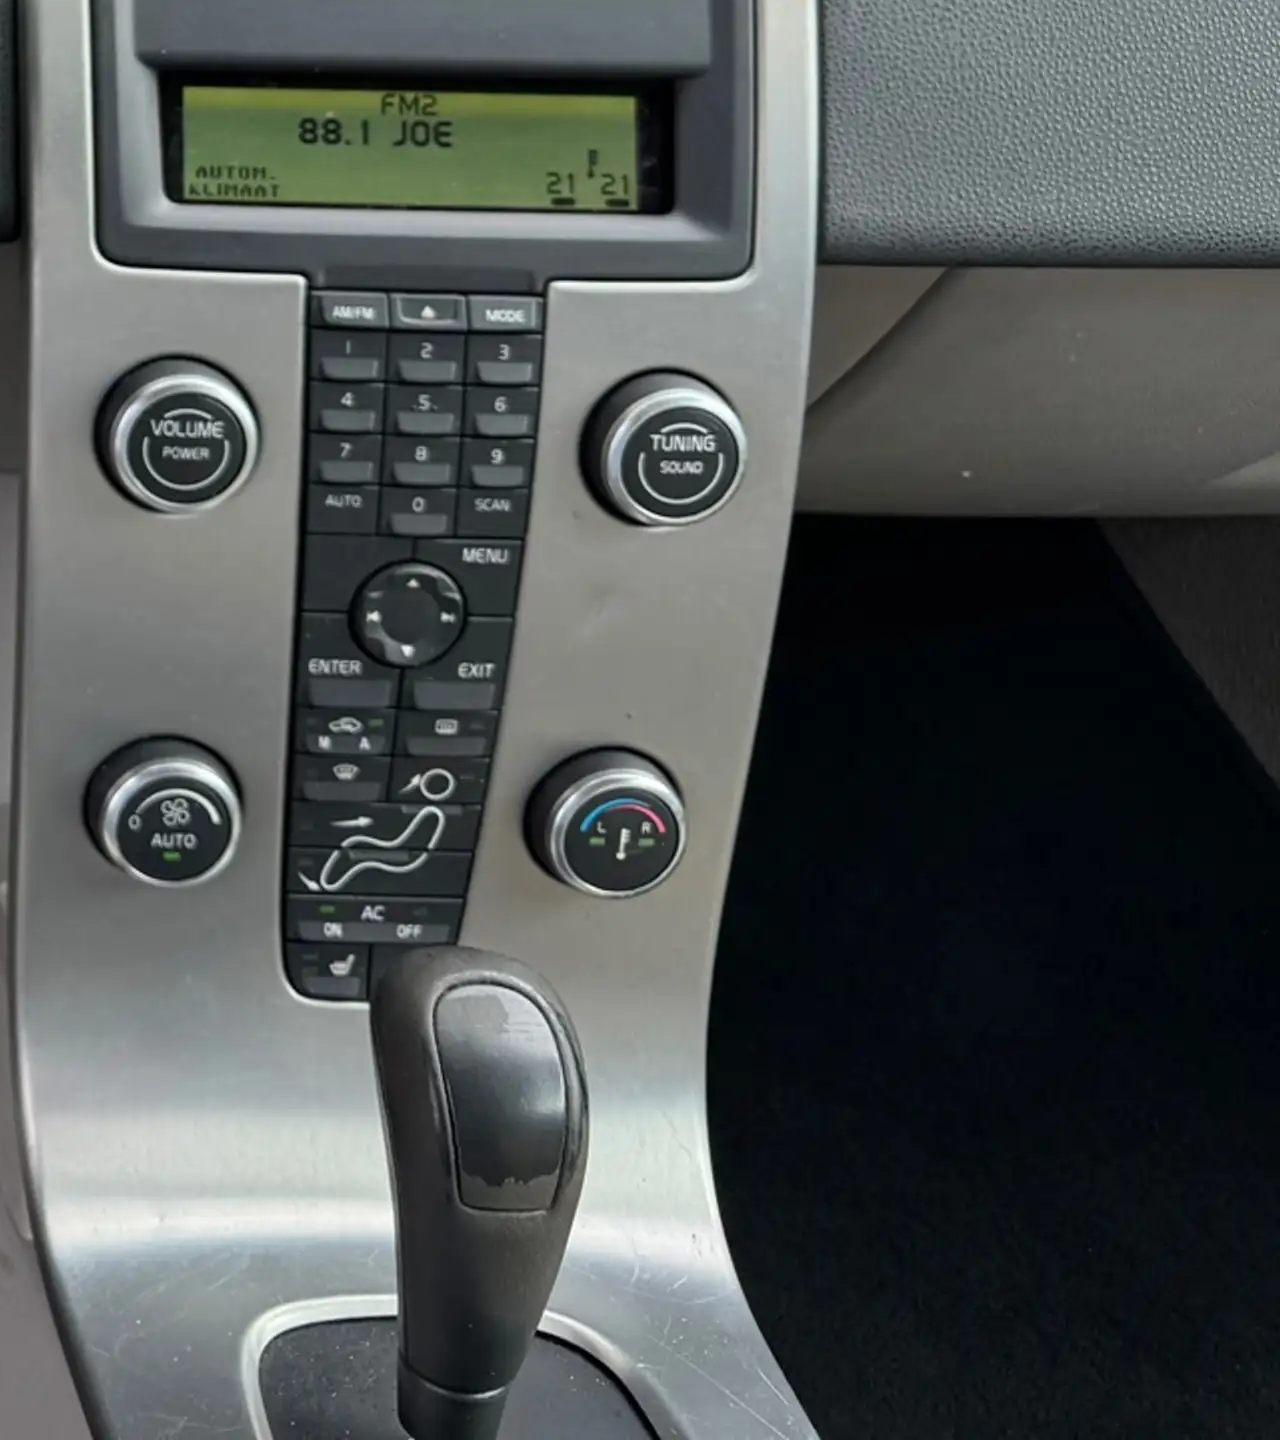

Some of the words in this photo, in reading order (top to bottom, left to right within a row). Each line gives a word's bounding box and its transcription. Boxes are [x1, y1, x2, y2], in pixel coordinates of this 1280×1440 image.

[381, 93, 441, 117] FM2
[298, 118, 371, 146] 88.1
[392, 120, 454, 148] JOE
[195, 165, 277, 182] AUTOM.
[188, 181, 281, 199] KLIMAAT
[545, 172, 576, 195] 21
[600, 173, 630, 196] 21
[484, 308, 526, 324] MODE
[420, 342, 434, 359] 2
[498, 344, 510, 360] 3
[340, 391, 354, 407] 4
[417, 393, 431, 410] 5
[494, 396, 507, 412] 6
[150, 418, 227, 440] VOLUME
[340, 442, 353, 459] 7
[649, 433, 718, 453] TUNING
[162, 445, 211, 461] POWER
[414, 445, 428, 461] 8
[491, 448, 504, 465] 9
[659, 459, 705, 475] SOUND
[324, 493, 364, 509] AUTO
[412, 496, 426, 512] 0
[474, 497, 512, 512] SCAN
[461, 547, 510, 565] MENU
[307, 658, 364, 676] ENTER
[457, 662, 497, 679] EXIT
[317, 734, 333, 751] M
[358, 736, 372, 751] A
[596, 820, 607, 834] L
[641, 820, 652, 834] R
[149, 832, 198, 850] AUTO
[360, 905, 387, 921] AC
[323, 922, 344, 938] ON
[396, 923, 424, 939] OFF
